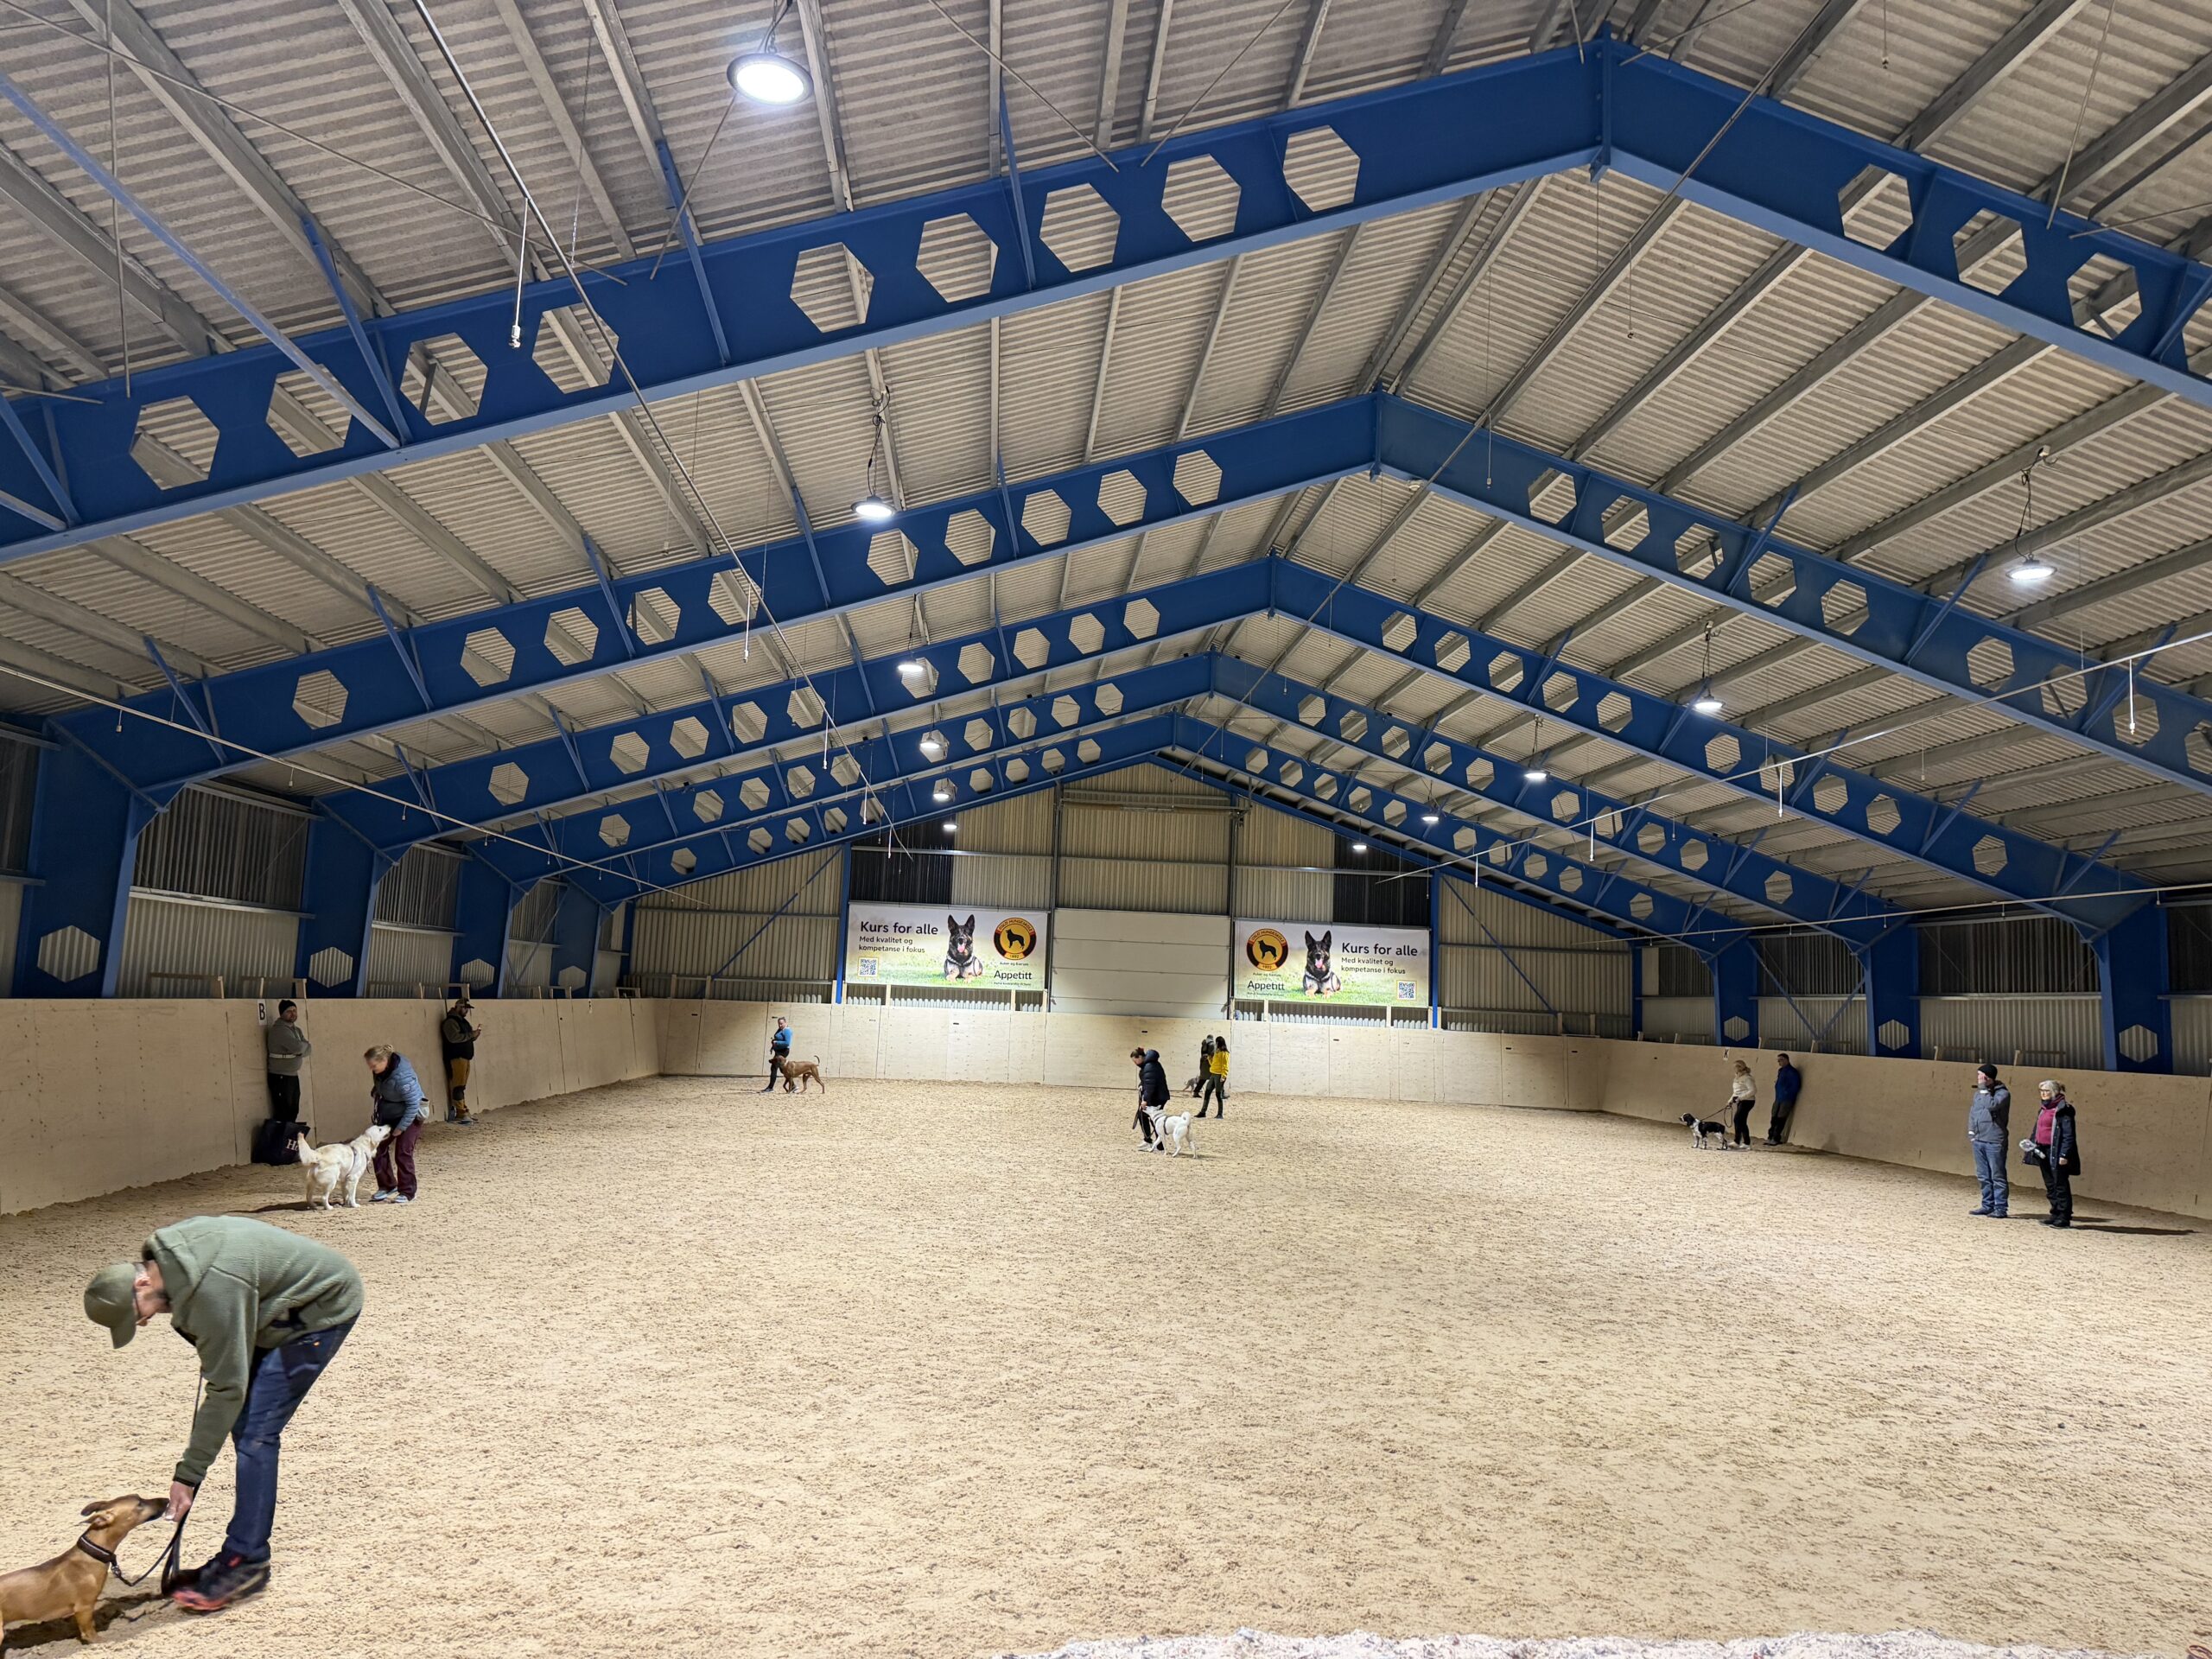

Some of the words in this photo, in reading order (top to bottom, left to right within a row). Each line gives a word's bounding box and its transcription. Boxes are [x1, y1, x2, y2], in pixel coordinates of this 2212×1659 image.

[860, 921, 889, 933] Kurs
[893, 922, 912, 934] for
[915, 923, 938, 935] alle
[858, 944, 901, 953] kompetanse
[906, 945, 925, 954] fokus
[1342, 942, 1370, 954] Kurs
[1373, 943, 1392, 955] for
[1395, 944, 1418, 957] alle
[994, 969, 1033, 981] Appetitt
[1247, 980, 1286, 992] Appetitt
[258, 1002, 265, 1020] B
